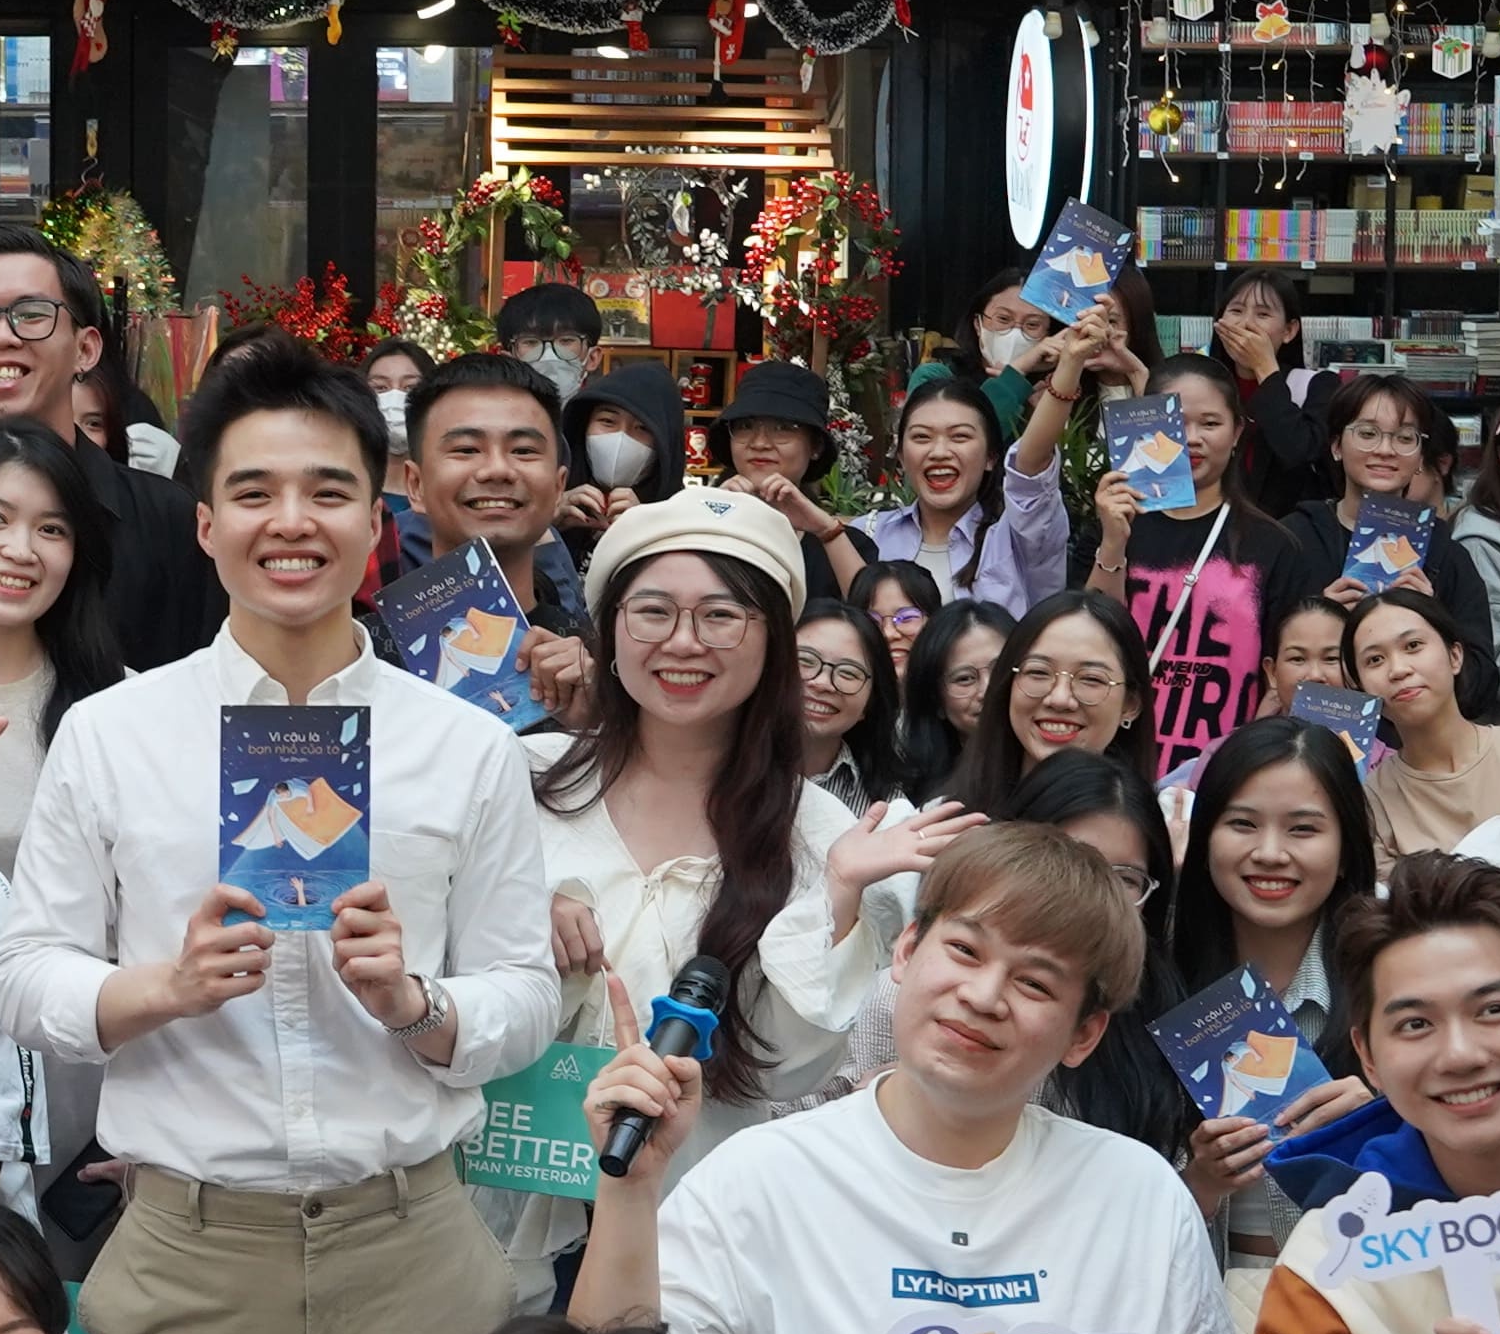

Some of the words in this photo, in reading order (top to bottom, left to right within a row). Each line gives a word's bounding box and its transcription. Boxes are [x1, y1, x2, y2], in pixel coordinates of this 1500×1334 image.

[248, 745, 271, 757] bạn
[274, 742, 298, 755] nhỏ
[299, 743, 323, 755] của
[268, 731, 281, 743] Vì
[283, 730, 306, 744] cậu
[308, 731, 320, 743] là
[489, 1100, 534, 1132] EE
[463, 1130, 594, 1171] BETTER
[505, 1163, 591, 1186] YESTERDAY
[1360, 1225, 1432, 1268] SKY
[897, 1274, 1032, 1302] LYHOPTINH
